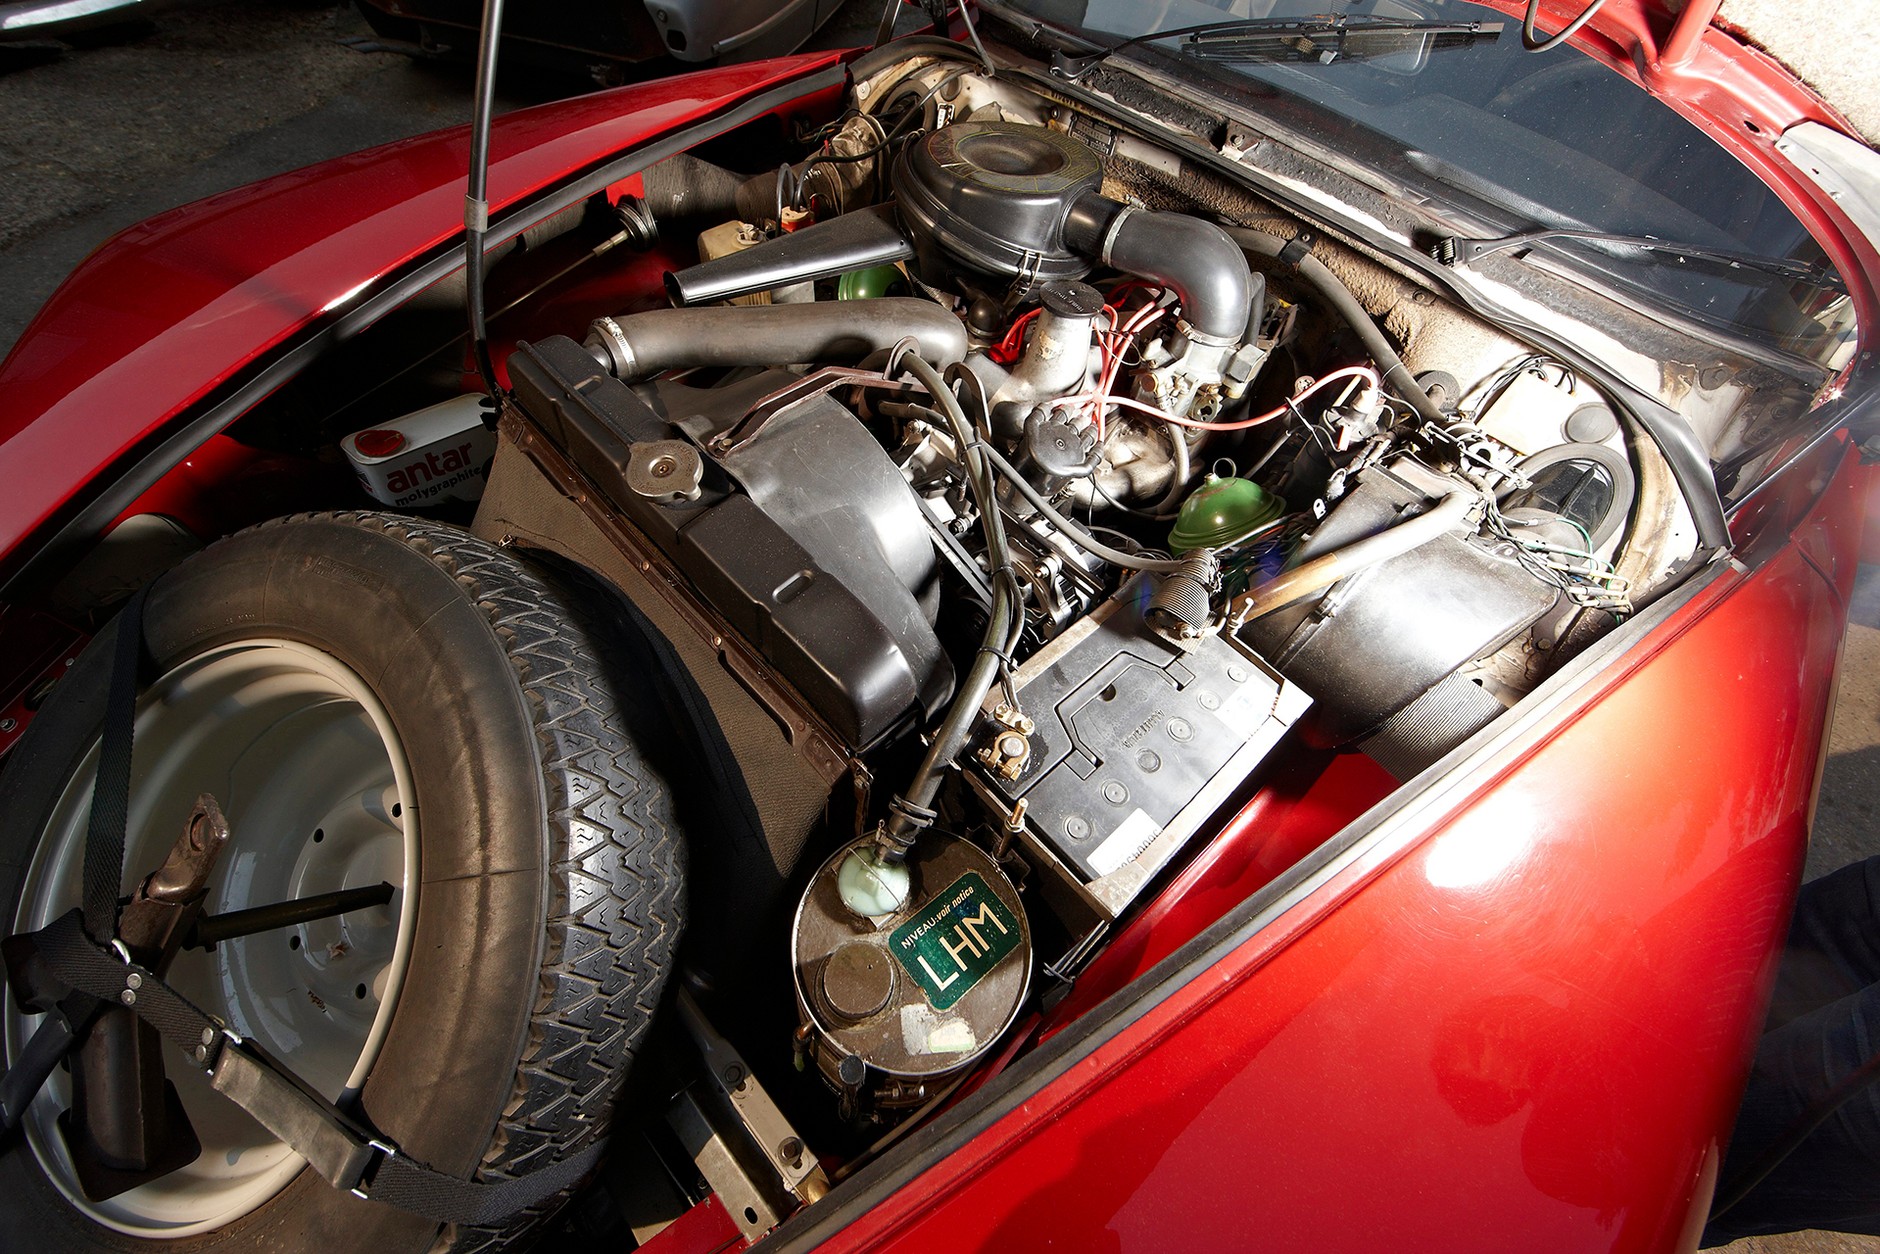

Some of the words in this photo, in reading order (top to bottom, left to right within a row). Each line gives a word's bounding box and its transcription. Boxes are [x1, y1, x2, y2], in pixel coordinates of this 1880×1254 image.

[386, 442, 472, 493] antar
[395, 466, 481, 506] molygraphite
[952, 886, 974, 908] notice
[917, 902, 1008, 991] LHM
